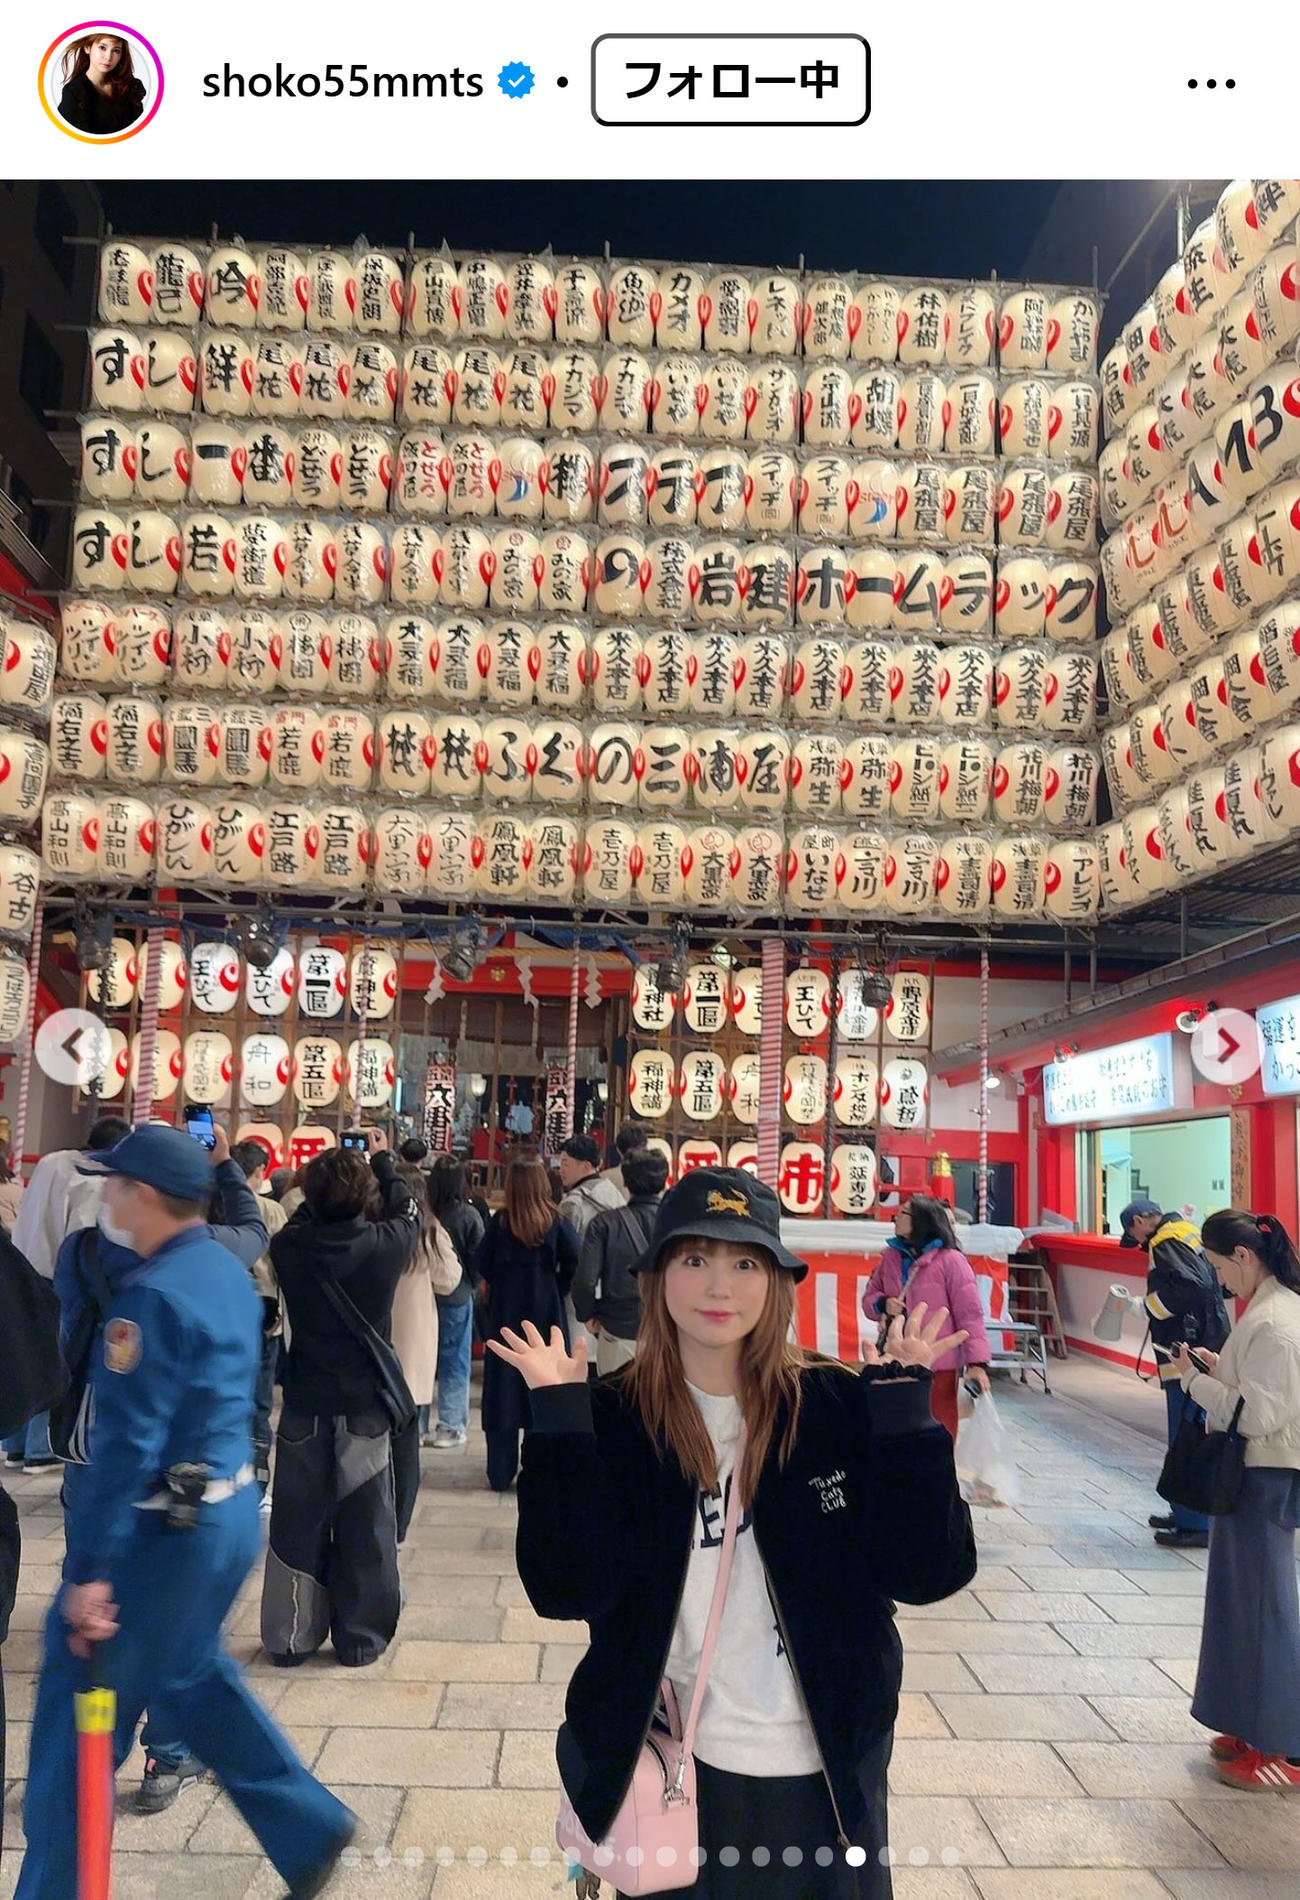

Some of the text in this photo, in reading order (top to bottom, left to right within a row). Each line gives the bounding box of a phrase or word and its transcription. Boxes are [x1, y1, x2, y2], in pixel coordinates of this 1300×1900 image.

[86, 429, 284, 484] すし一番
[605, 632, 632, 700] 米久本店
[656, 634, 683, 702] 米久本店
[701, 636, 728, 704] 米久本店
[748, 639, 778, 708] 米久本店
[809, 644, 838, 711] 米久本店
[860, 646, 886, 713] 米久本店
[908, 650, 938, 717] 米久本店
[955, 650, 984, 717] 米久本店
[1015, 654, 1044, 720] 米久本店
[1061, 657, 1092, 725] 米久本店
[809, 756, 835, 806] 弥生
[859, 758, 886, 809] 弥生
[269, 811, 299, 874] 江戸路
[324, 813, 352, 876] 江戸路
[801, 853, 829, 901] いなせ
[808, 1469, 846, 1490] Tuxedo
